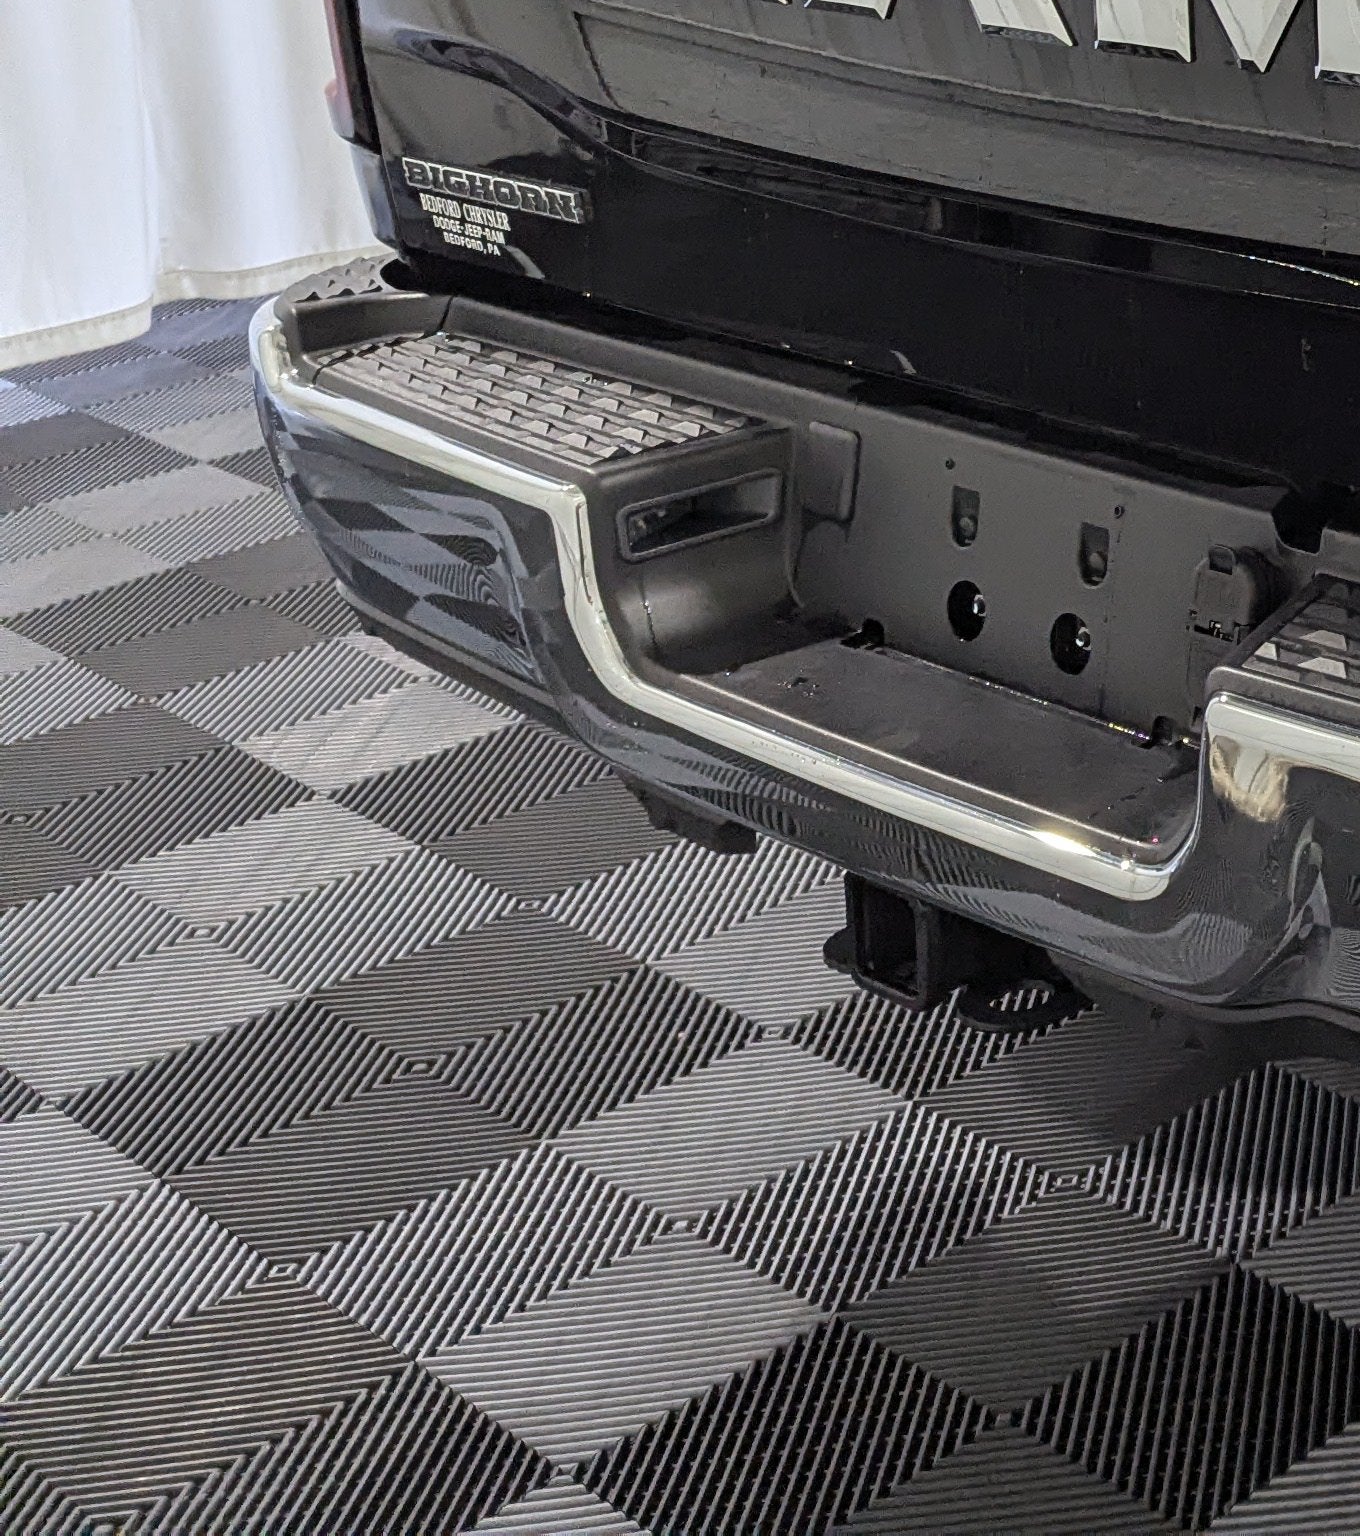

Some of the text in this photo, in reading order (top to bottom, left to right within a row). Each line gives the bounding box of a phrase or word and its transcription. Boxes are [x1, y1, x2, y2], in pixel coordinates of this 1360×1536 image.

[402, 156, 580, 224] BIGHORN
[419, 192, 511, 231] BEDFORD CHRYSLER
[487, 243, 501, 256] PA
